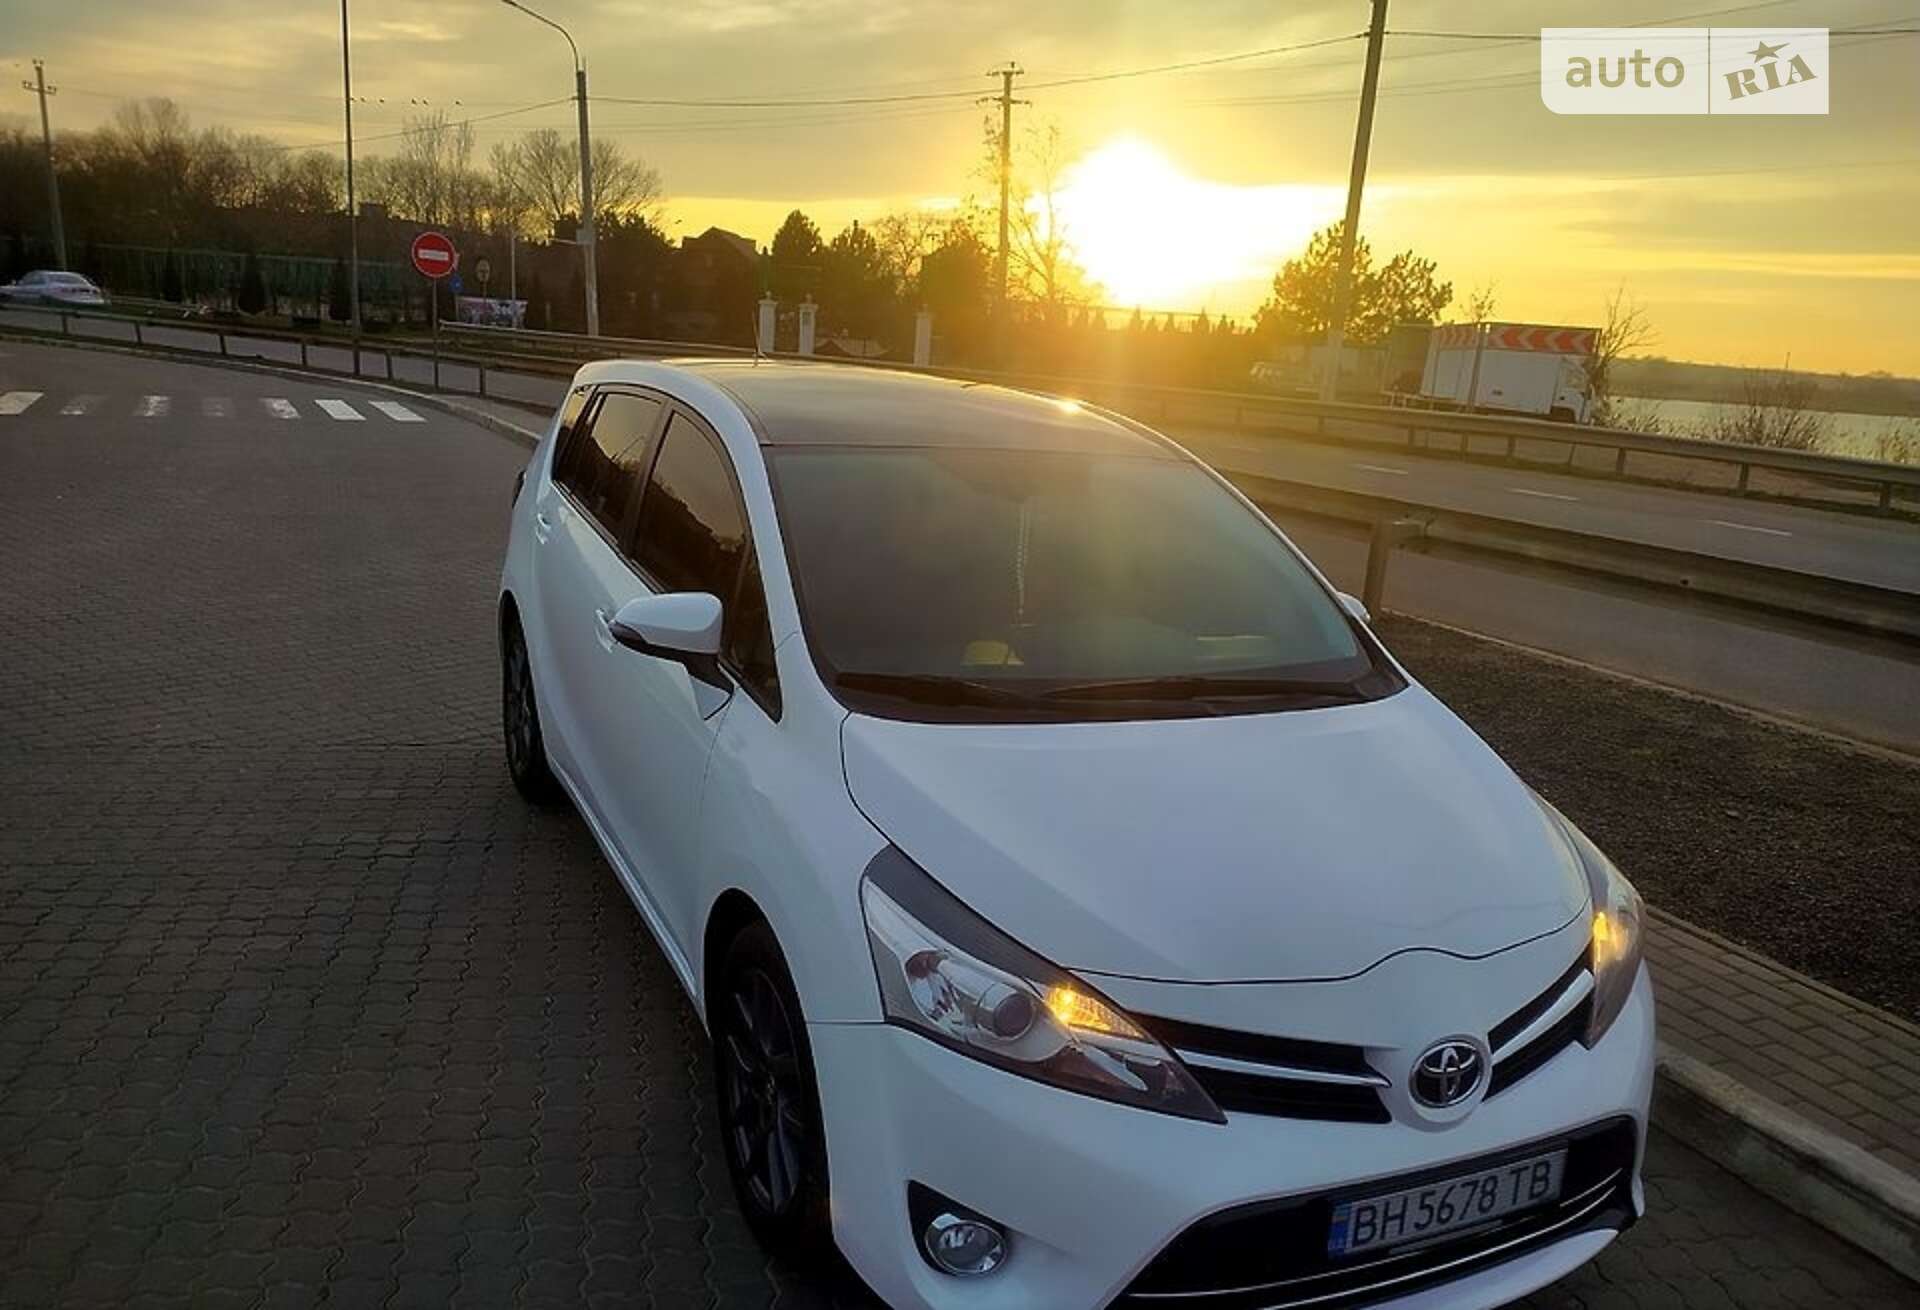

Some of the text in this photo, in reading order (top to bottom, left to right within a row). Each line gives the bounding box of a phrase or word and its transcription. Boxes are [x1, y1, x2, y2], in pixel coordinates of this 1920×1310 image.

[1352, 1162, 1551, 1248] BH 5678 TB
